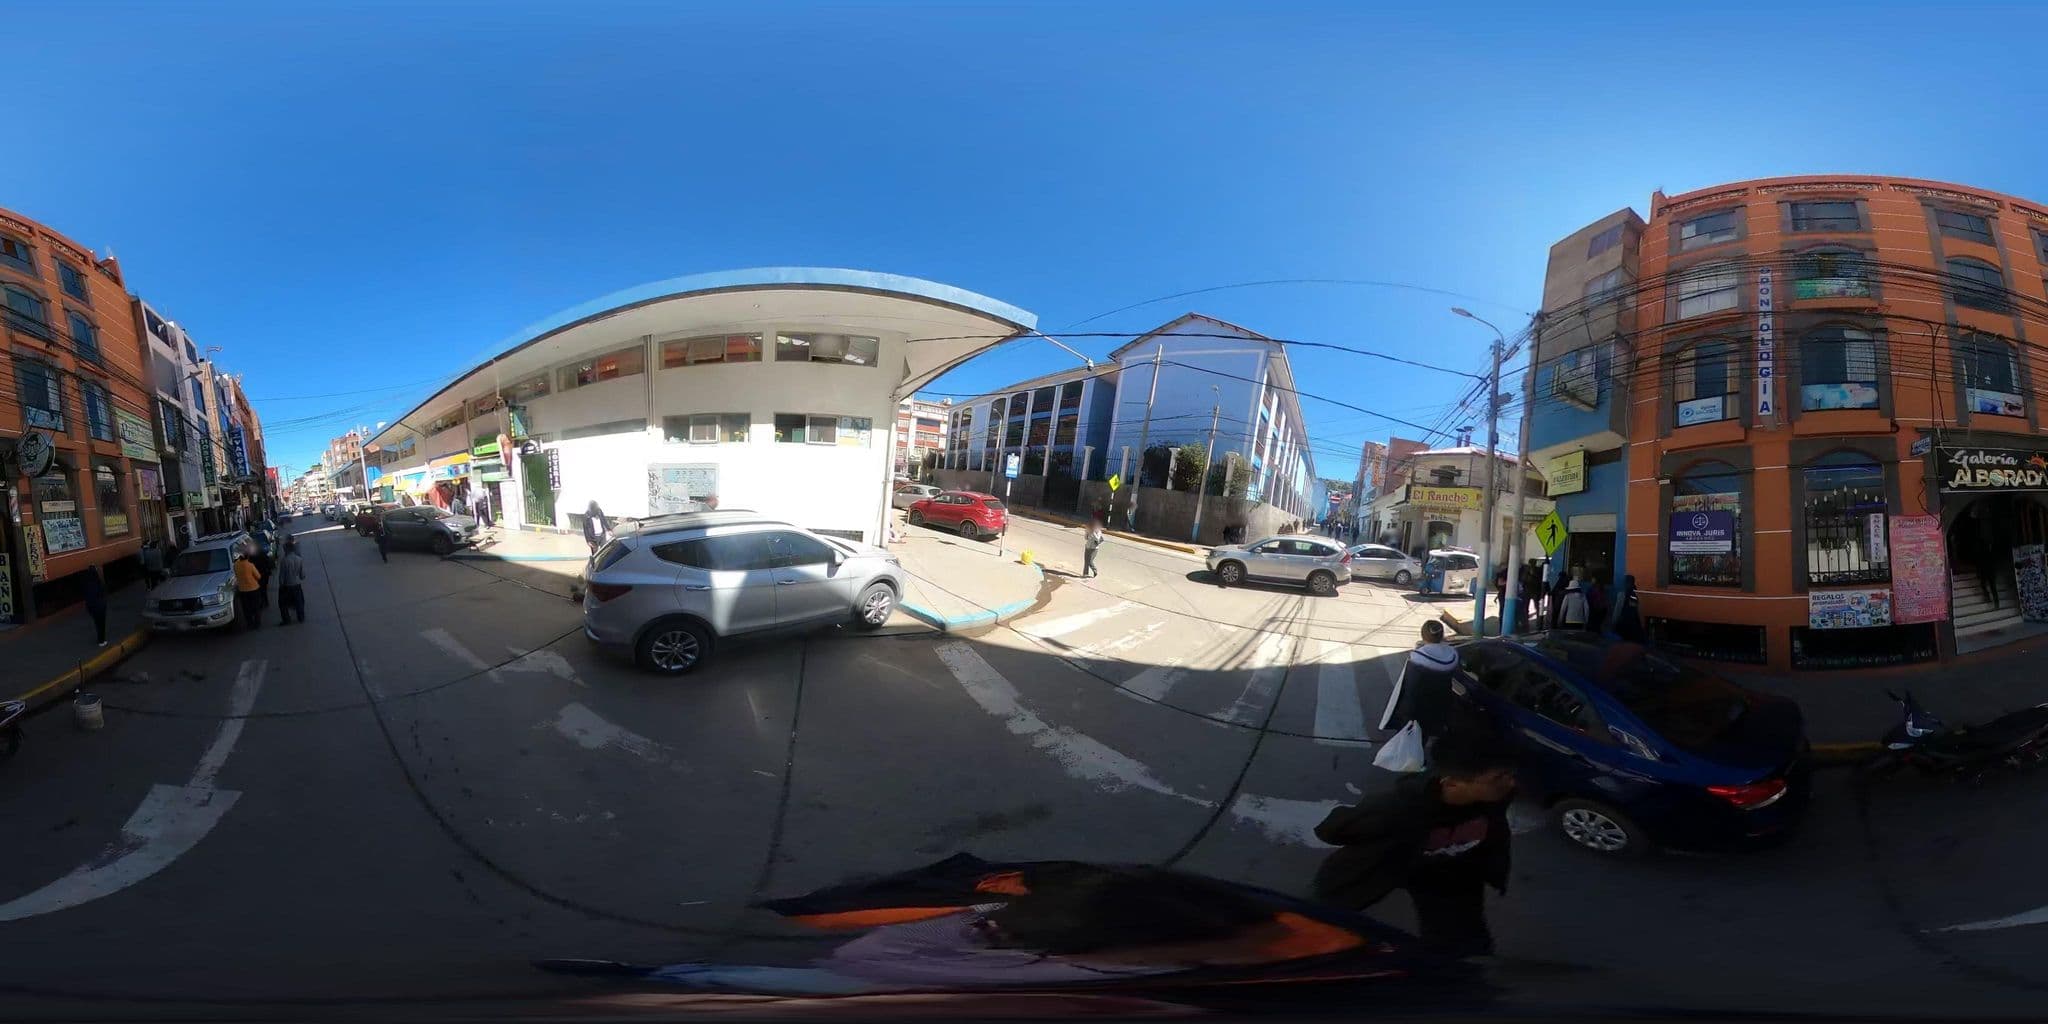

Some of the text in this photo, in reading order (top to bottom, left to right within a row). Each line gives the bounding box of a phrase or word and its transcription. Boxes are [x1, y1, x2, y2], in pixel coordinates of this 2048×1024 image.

[1760, 267, 1770, 413] ODONTOLOGÍA
[1948, 450, 2018, 468] Galería
[1413, 490, 1424, 500] El
[1427, 490, 1469, 503] Rancho
[1703, 529, 1725, 537] JURIS
[1812, 593, 1845, 601] REGALOS
